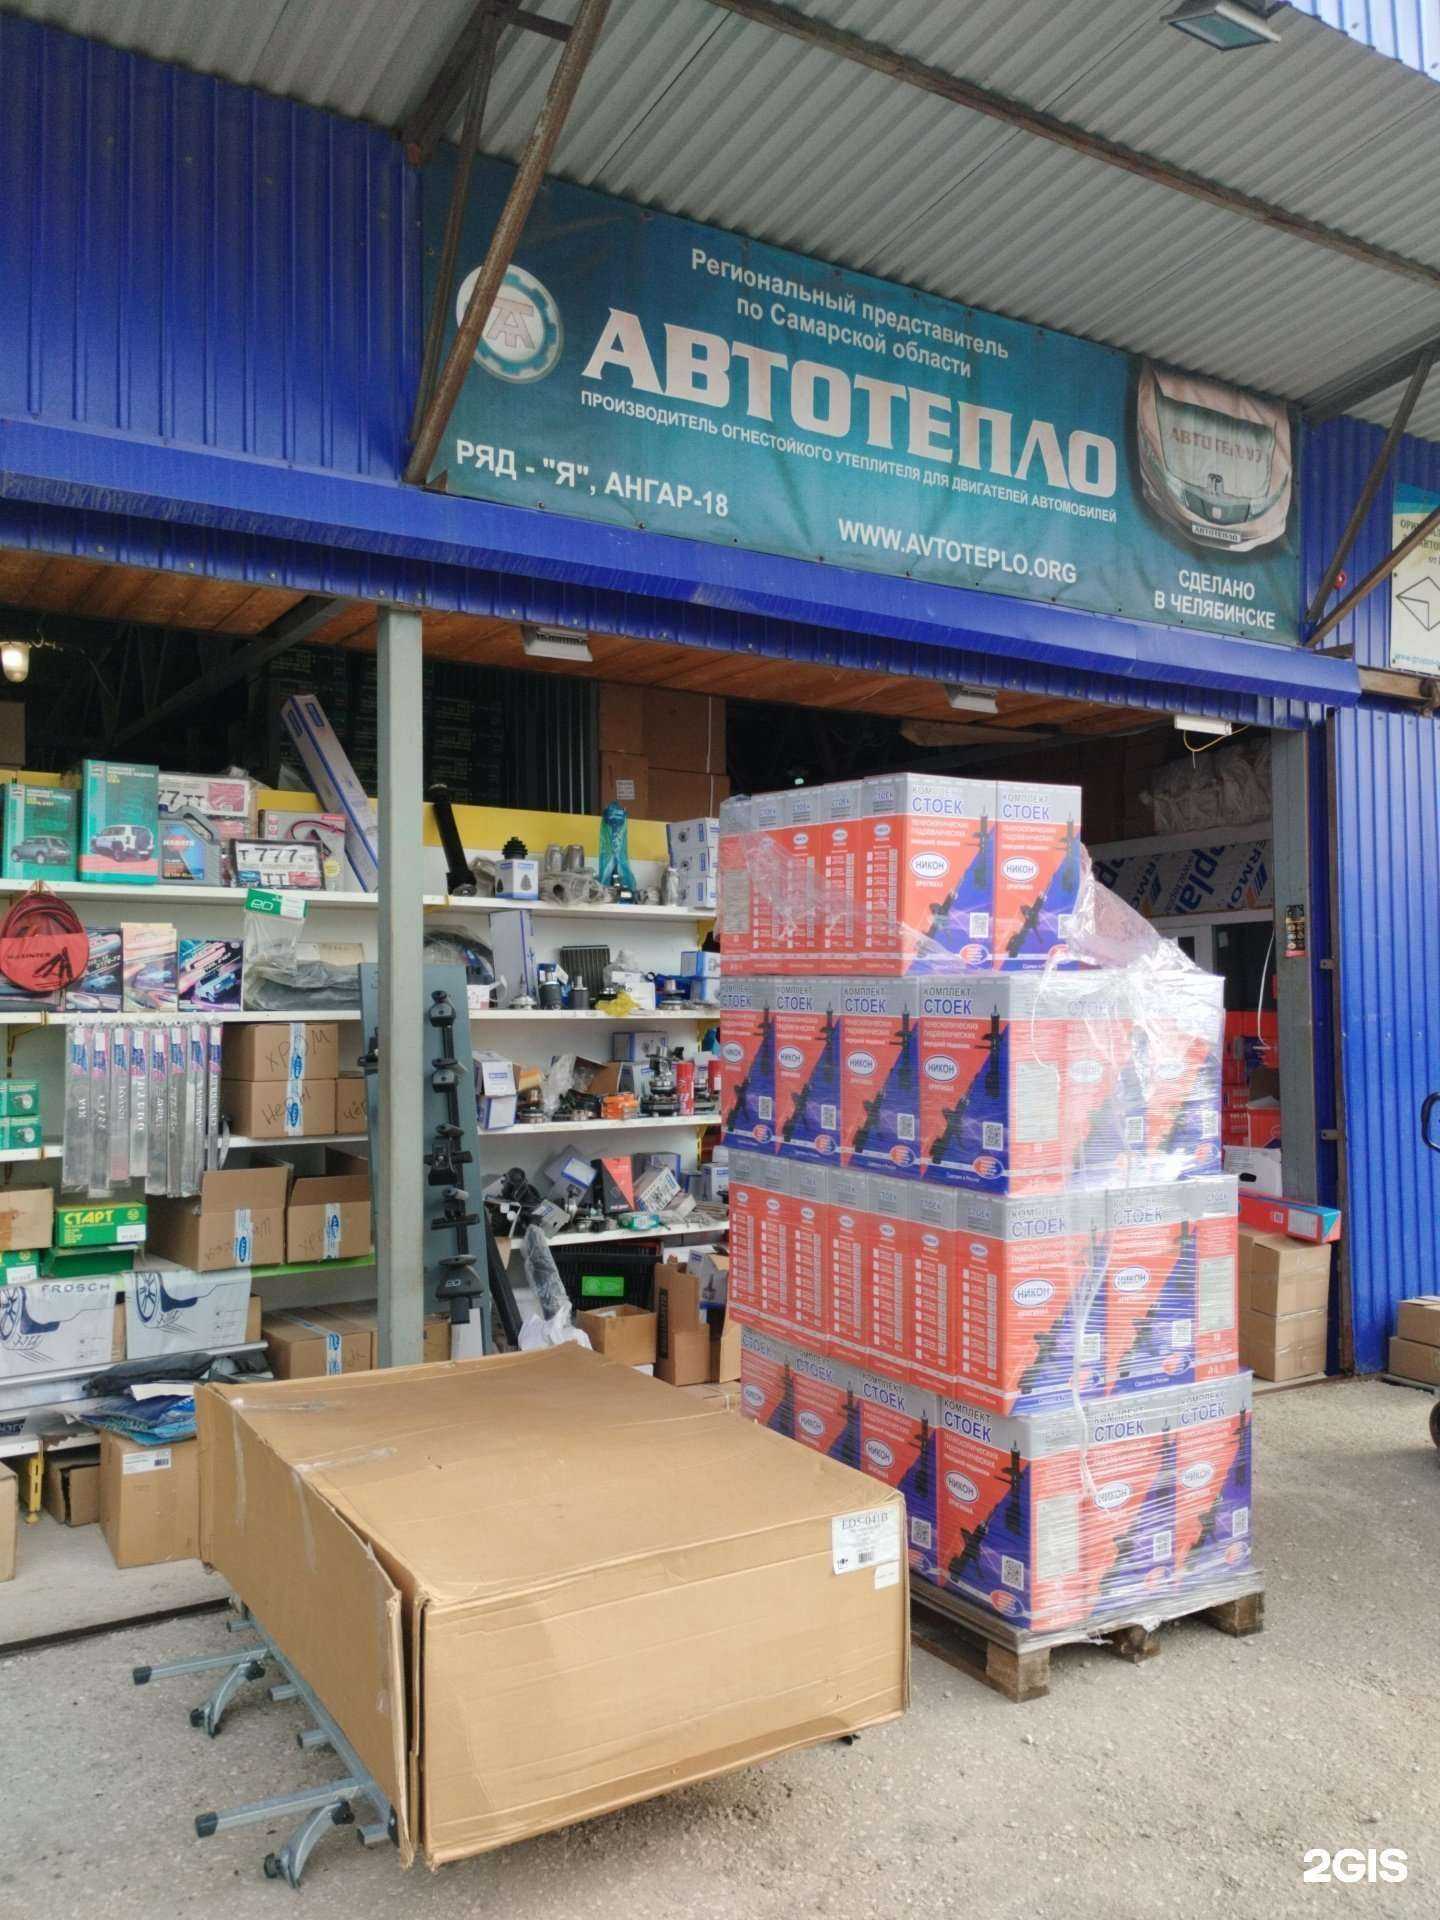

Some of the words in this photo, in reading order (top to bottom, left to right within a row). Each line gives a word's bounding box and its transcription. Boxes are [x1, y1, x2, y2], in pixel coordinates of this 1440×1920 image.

[691, 247, 856, 316] Региональный
[862, 302, 1009, 359] представитель
[736, 297, 764, 321] по
[770, 303, 886, 355] Самарской
[892, 339, 972, 378] области
[581, 306, 1117, 499] АВТОТЕПЛО
[580, 390, 719, 435] ПРОИЗВОДИТЕЛЬ
[721, 422, 832, 463] ОГНЕСТОЙКОГО
[835, 450, 921, 481] УТЕПЛИТЕЛЯ
[923, 470, 950, 488] ДЛЯ
[951, 477, 1029, 505] ДВИГАТЕЛЕЙ
[1031, 494, 1118, 524] АВТОМОБИЛЕЙ
[456, 439, 517, 481] РЯД
[603, 471, 730, 518] АНГАР-18
[838, 518, 1078, 584] WWW.AVTOTEPLO.ORG
[1178, 569, 1256, 601] СДЕЛАНО
[1154, 590, 1166, 610] В
[1170, 592, 1277, 630] ЧЕЛЯБИНСКЕ
[912, 797, 963, 816] СТОЕК
[1002, 803, 1050, 821] СТОЕК
[914, 860, 946, 871] НИКОН
[1006, 864, 1035, 875] НИКОН
[776, 996, 813, 1012] СТОЕК
[845, 998, 886, 1014] СТОЕК
[923, 998, 972, 1016] СТОЕК
[927, 1062, 955, 1075] НИКОН
[63, 1209, 115, 1225] СТАРТ
[41, 1283, 110, 1293] FROSCH
[1017, 1287, 1050, 1299] НИКОН
[795, 1357, 834, 1383] СТОЕК
[863, 1384, 905, 1411] СТОЕК
[943, 1400, 991, 1422] КОМПЛЕКТ
[1180, 1401, 1225, 1425] СТОЕК
[943, 1411, 992, 1442] СТОЕК
[1094, 1420, 1145, 1443] СТОЕК
[947, 1477, 974, 1496] НИКОН
